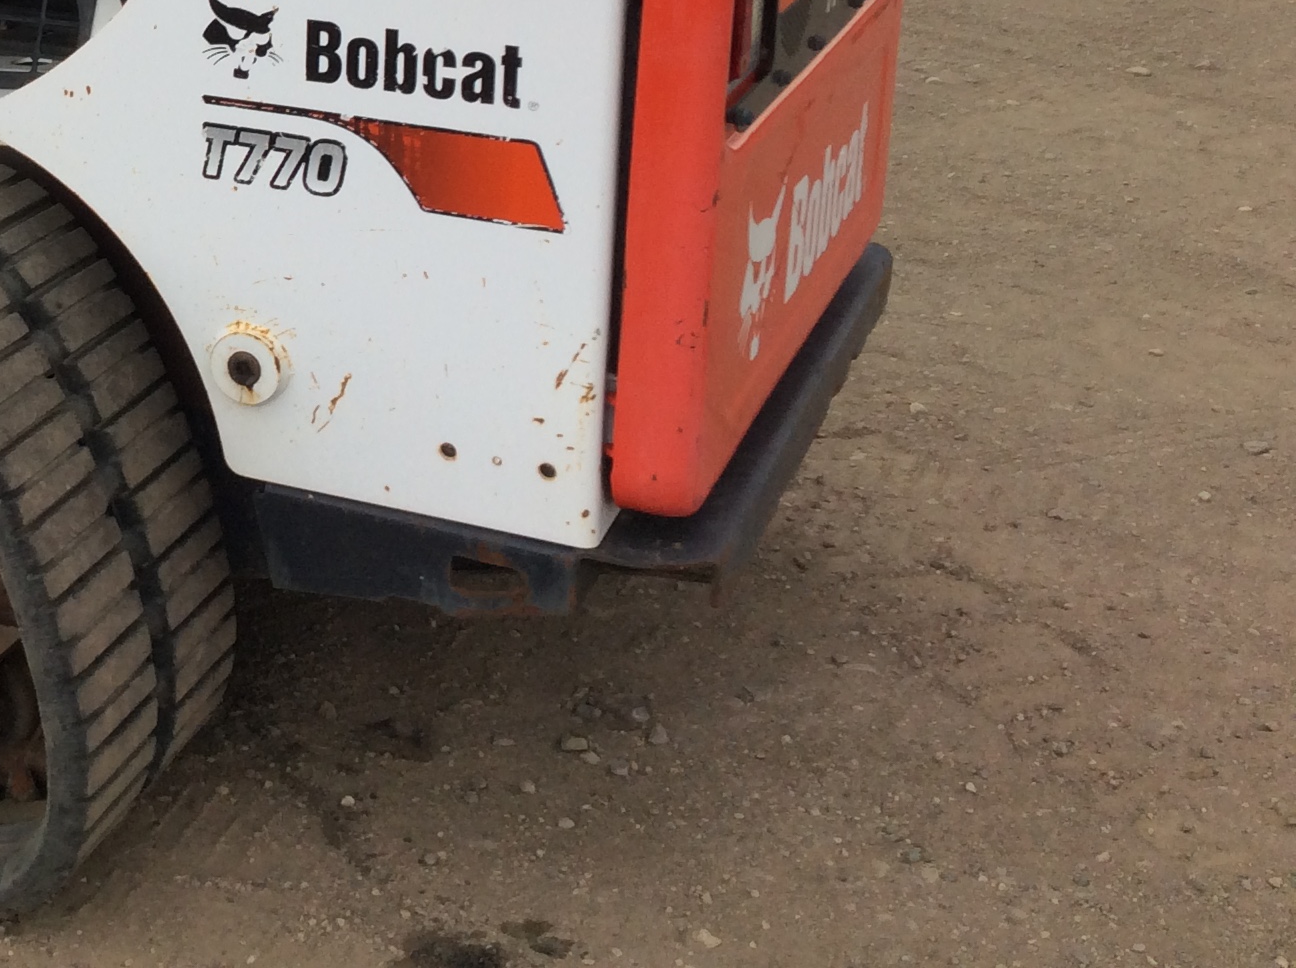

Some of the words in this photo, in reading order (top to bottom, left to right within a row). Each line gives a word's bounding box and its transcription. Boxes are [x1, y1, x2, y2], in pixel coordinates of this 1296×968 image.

[305, 18, 523, 109] Bobcat
[202, 121, 349, 198] T770
[783, 100, 869, 305] Bobcat
